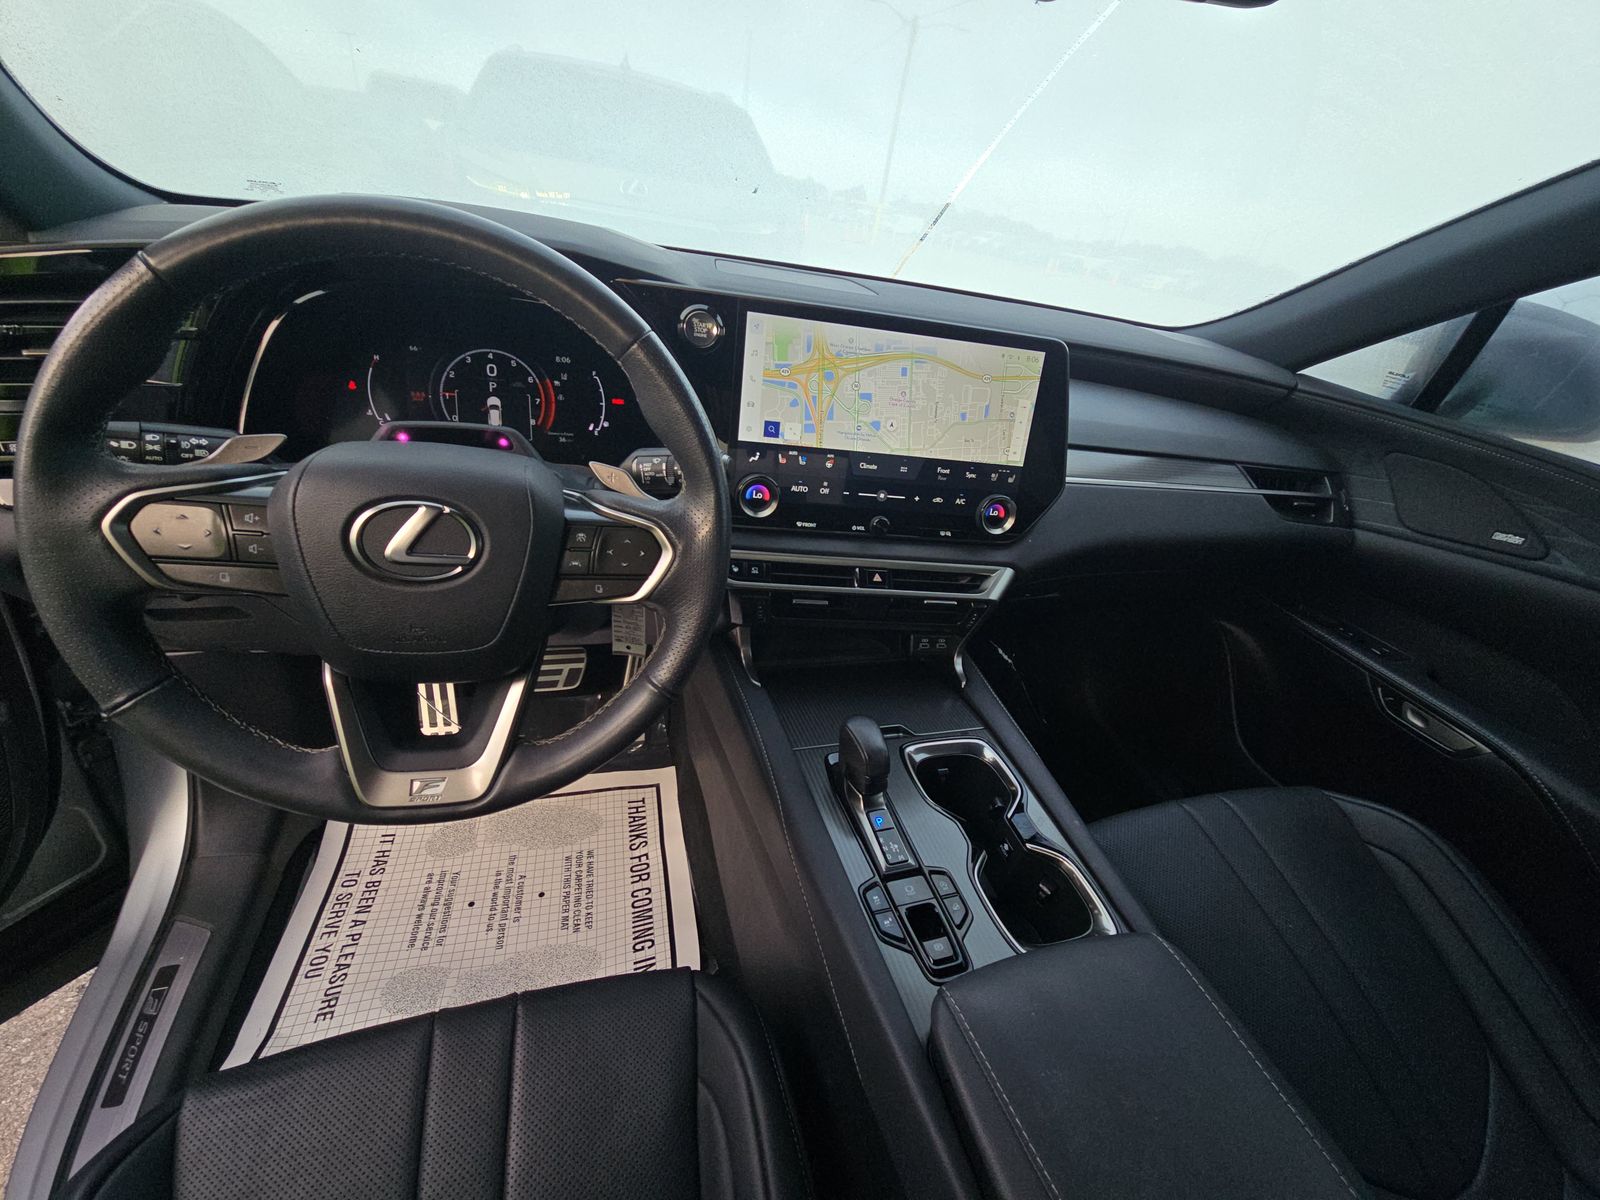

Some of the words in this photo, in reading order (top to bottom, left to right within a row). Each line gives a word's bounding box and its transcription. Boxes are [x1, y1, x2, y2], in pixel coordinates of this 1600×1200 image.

[555, 356, 571, 364] 8:06
[489, 382, 497, 392] P
[859, 462, 878, 470] Climate
[937, 467, 950, 475] Front
[965, 471, 977, 479] Sync
[752, 490, 763, 499] Lo
[790, 485, 808, 493] AUTO
[820, 487, 830, 495] Off
[989, 508, 998, 516] Lo
[627, 797, 649, 852] THANKS
[875, 816, 884, 827] P
[379, 833, 396, 845] IT
[368, 849, 391, 876] HAS
[508, 854, 517, 866] the
[576, 850, 584, 869] YOUR
[586, 849, 595, 859] WE
[564, 855, 572, 873] WITH
[586, 860, 595, 878] HAVE
[630, 852, 651, 885] FOR
[340, 869, 362, 889] TO
[425, 872, 435, 885] are
[450, 870, 462, 887] Your
[493, 878, 502, 890] the
[505, 867, 514, 885] most
[563, 874, 572, 890] THIS
[431, 870, 449, 906] improving
[573, 869, 583, 909] CARPETING
[585, 880, 594, 900] TRIED
[356, 880, 381, 915] BEEN
[417, 887, 431, 911] always
[489, 891, 499, 912] world
[500, 886, 512, 921] important
[514, 881, 525, 917] customer
[561, 890, 571, 914] PAPER
[585, 901, 594, 911] TO
[319, 892, 353, 941] SERVE
[429, 908, 438, 921] our
[439, 888, 456, 934] suggestions
[487, 913, 496, 922] to
[631, 887, 656, 953] COMING
[348, 919, 367, 930] A
[560, 915, 570, 931] MAT
[572, 910, 582, 933] CLEAN
[584, 912, 593, 930] KEEP
[420, 922, 435, 951] service
[435, 935, 447, 947] for
[496, 923, 507, 950] person
[304, 943, 336, 980] YOU
[314, 932, 363, 1024] PLEASURE
[118, 1020, 149, 1080] SPORT
